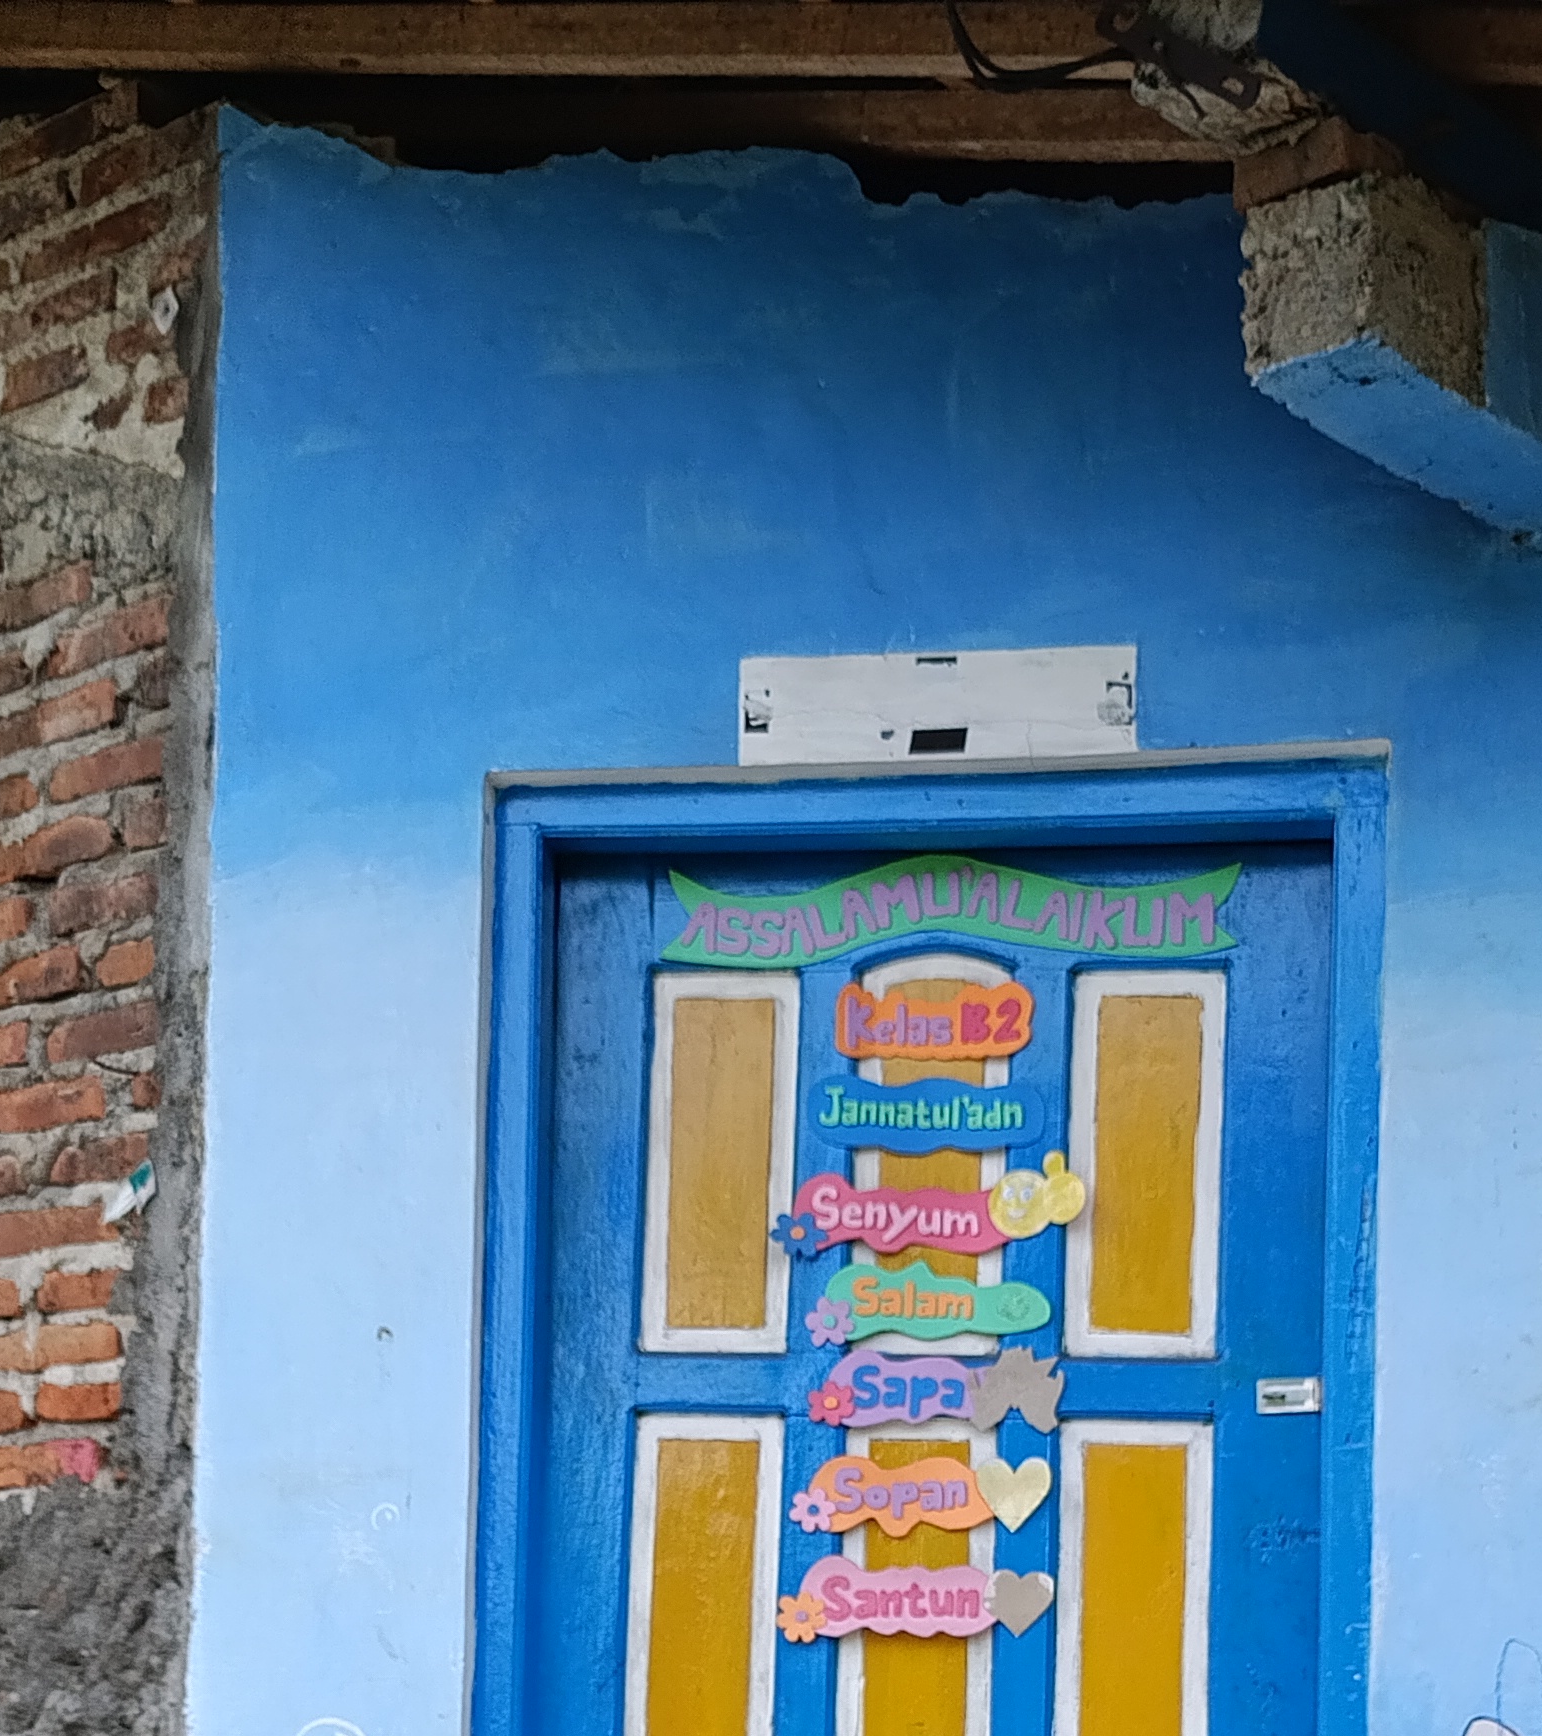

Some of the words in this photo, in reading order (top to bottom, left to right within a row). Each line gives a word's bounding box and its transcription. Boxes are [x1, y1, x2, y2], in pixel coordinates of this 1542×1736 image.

[680, 865, 1216, 957] ASSALAMU'ALAIKUM
[845, 996, 953, 1045] Kelas
[960, 1000, 1022, 1044] B2
[811, 1184, 979, 1242] Senyum
[852, 1276, 974, 1320] Salam
[851, 1365, 966, 1418] Sapa
[834, 1467, 967, 1518] Sopan
[822, 1575, 980, 1623] Santun
